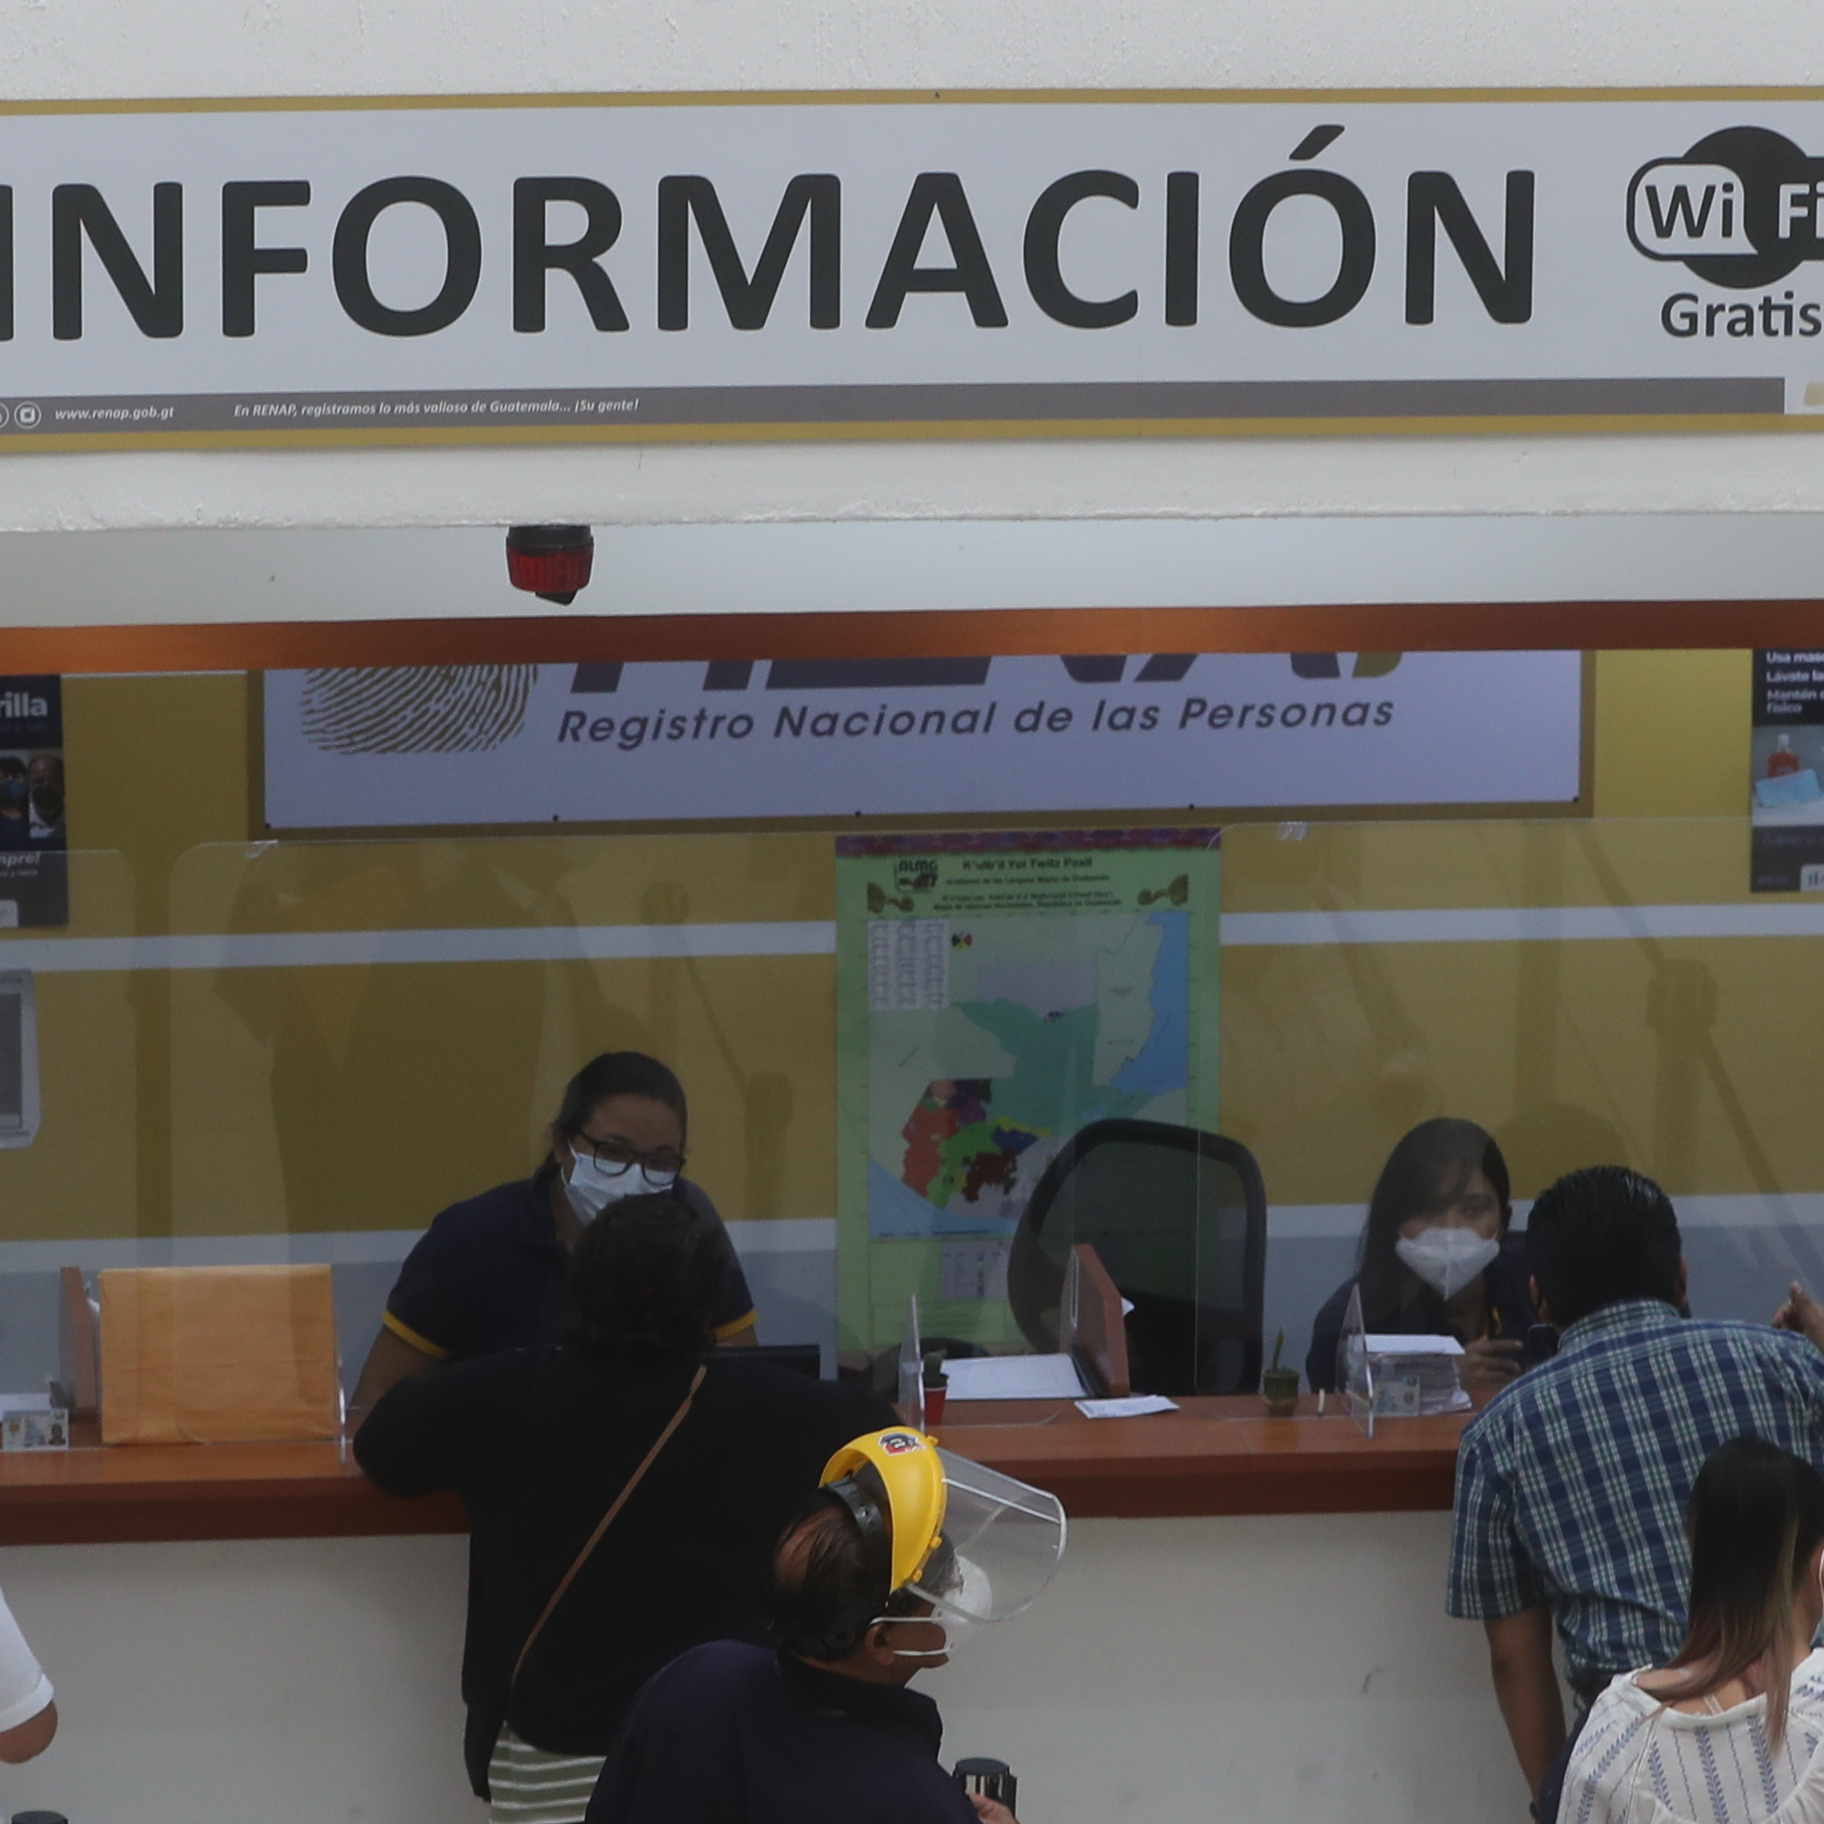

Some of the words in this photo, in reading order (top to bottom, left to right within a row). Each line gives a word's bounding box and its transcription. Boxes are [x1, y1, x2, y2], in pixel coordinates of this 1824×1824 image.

[1660, 290, 1823, 338] Gratis
[54, 404, 175, 421] www.renap.gob.gt
[233, 404, 250, 418] En
[252, 403, 298, 418] RENAP,
[301, 402, 376, 418] registramos
[378, 401, 391, 415] lo
[393, 400, 420, 415] más
[422, 400, 469, 415] valioso
[471, 400, 488, 414] de
[489, 399, 571, 414] Guatemala...
[598, 398, 639, 415] gente!
[556, 707, 754, 751] Registro
[774, 701, 998, 739] Nacional
[1013, 700, 1073, 733] de
[1092, 699, 1161, 731] las
[1178, 697, 1395, 730] Personas
